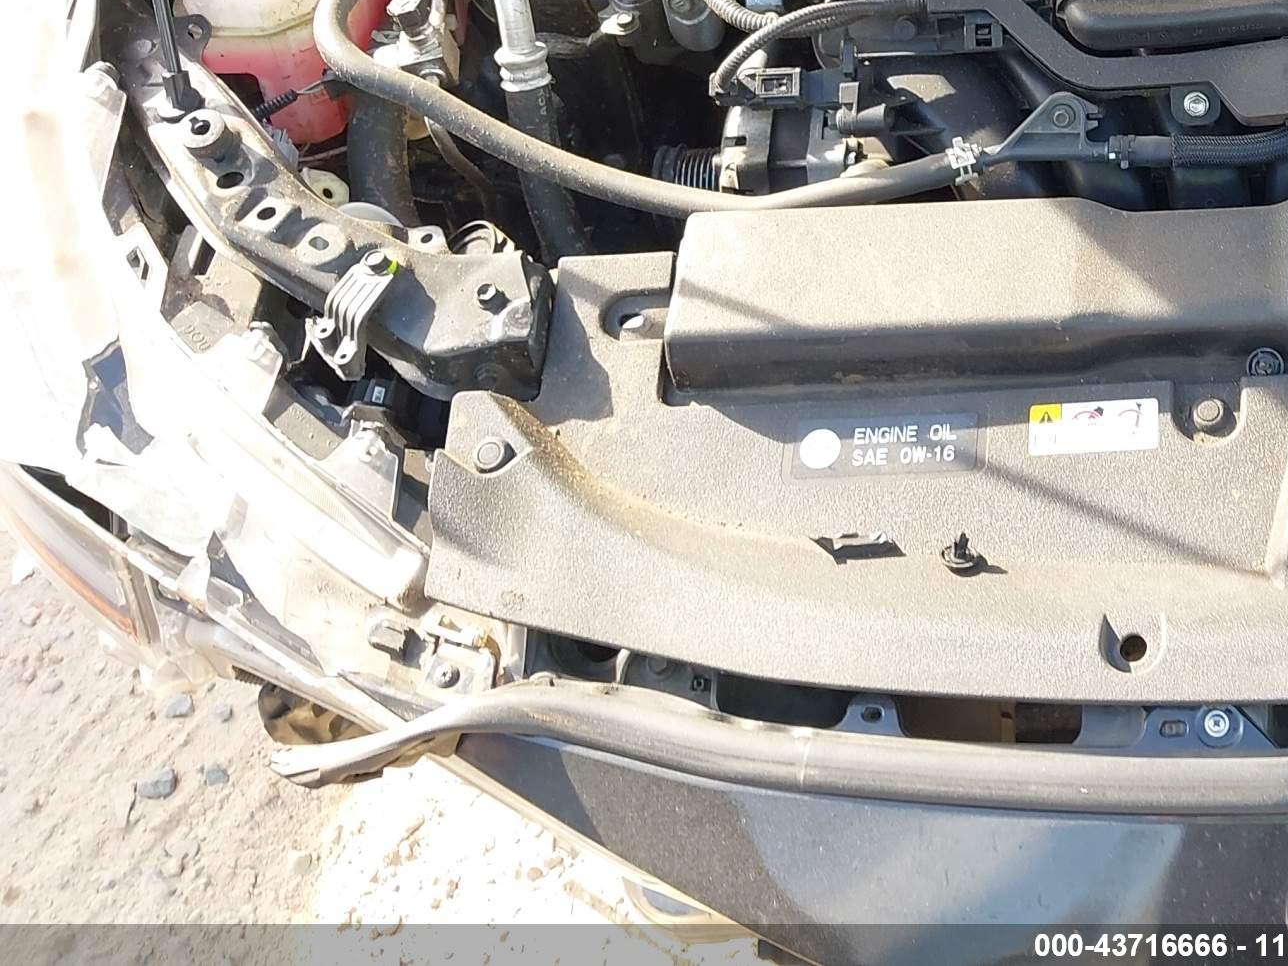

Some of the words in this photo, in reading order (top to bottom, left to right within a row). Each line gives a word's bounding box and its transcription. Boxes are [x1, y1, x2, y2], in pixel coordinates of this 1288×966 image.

[853, 425, 918, 445] ENGINE
[929, 423, 957, 441] OIL
[851, 447, 888, 467] SAE
[900, 444, 955, 465] 0W-16
